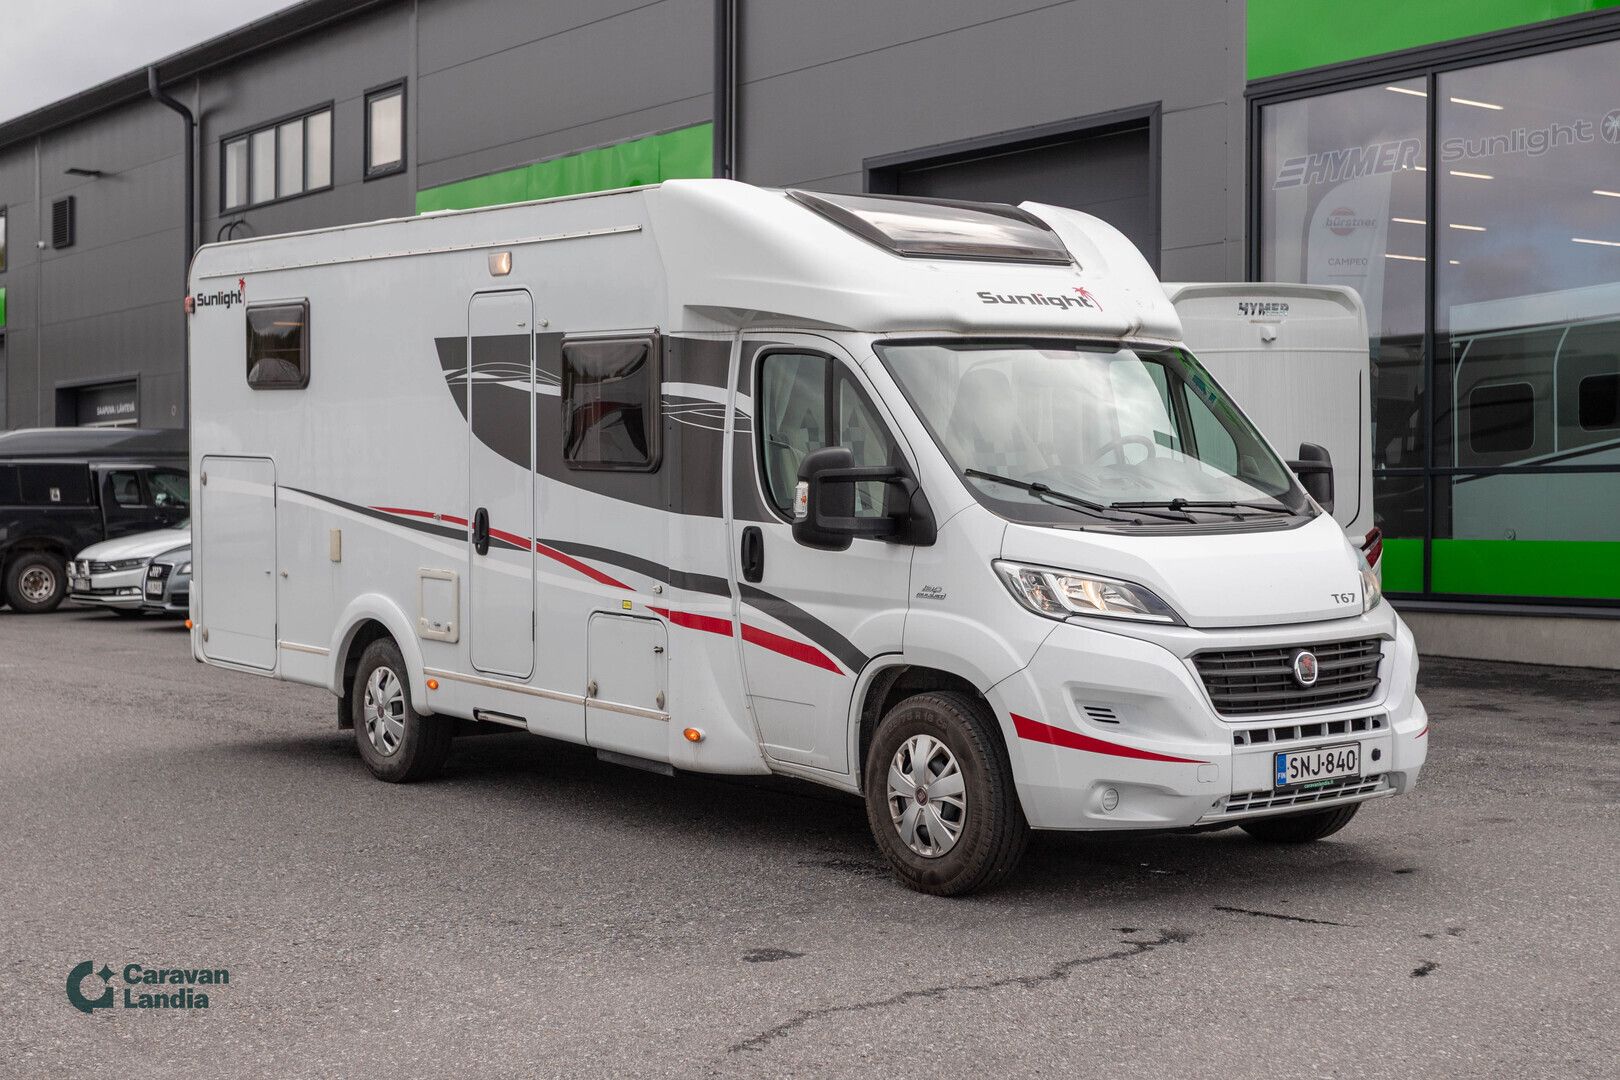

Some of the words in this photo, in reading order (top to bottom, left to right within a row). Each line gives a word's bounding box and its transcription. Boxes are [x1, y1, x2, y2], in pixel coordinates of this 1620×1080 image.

[1441, 119, 1594, 162] Sunlight
[1300, 138, 1421, 186] HYMER
[1327, 257, 1369, 266] CAMPEO
[196, 290, 242, 309] Sunlight
[976, 291, 1094, 310] Sunlight
[1238, 302, 1290, 316] HYMER
[1330, 592, 1356, 604] T67
[1290, 750, 1356, 779] SNJ-840
